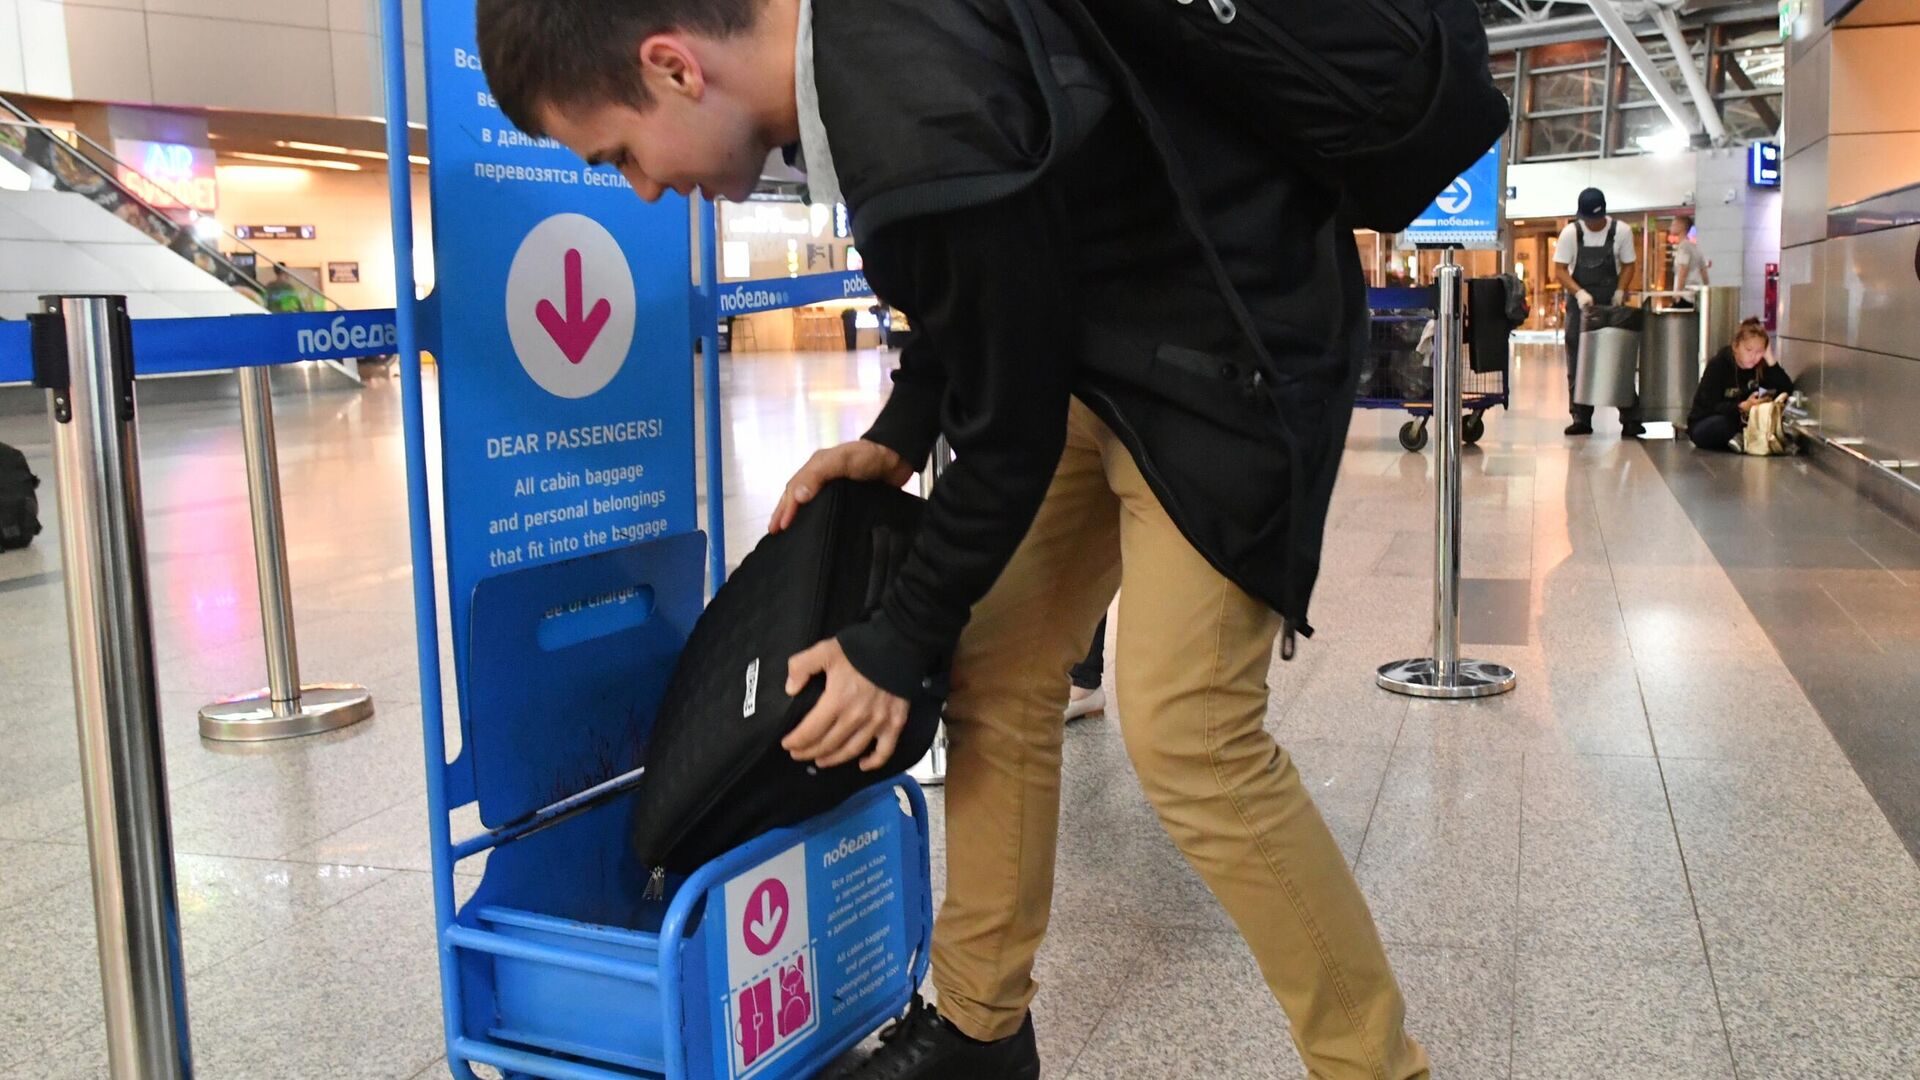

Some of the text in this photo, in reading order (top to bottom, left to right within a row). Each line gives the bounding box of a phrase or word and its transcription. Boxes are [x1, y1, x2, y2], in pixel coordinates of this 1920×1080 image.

[477, 91, 498, 109] ве
[482, 128, 492, 143] в
[474, 162, 578, 185] перевозятся
[720, 285, 769, 312] победа
[843, 272, 871, 298] pobe
[297, 315, 397, 354] победа
[486, 419, 663, 459] DEAR PASSENGERS!
[514, 464, 644, 497] All cabin baggage
[489, 489, 666, 535] and personal belongings
[489, 518, 668, 568] that fit into the baggage
[823, 831, 871, 868] победа
